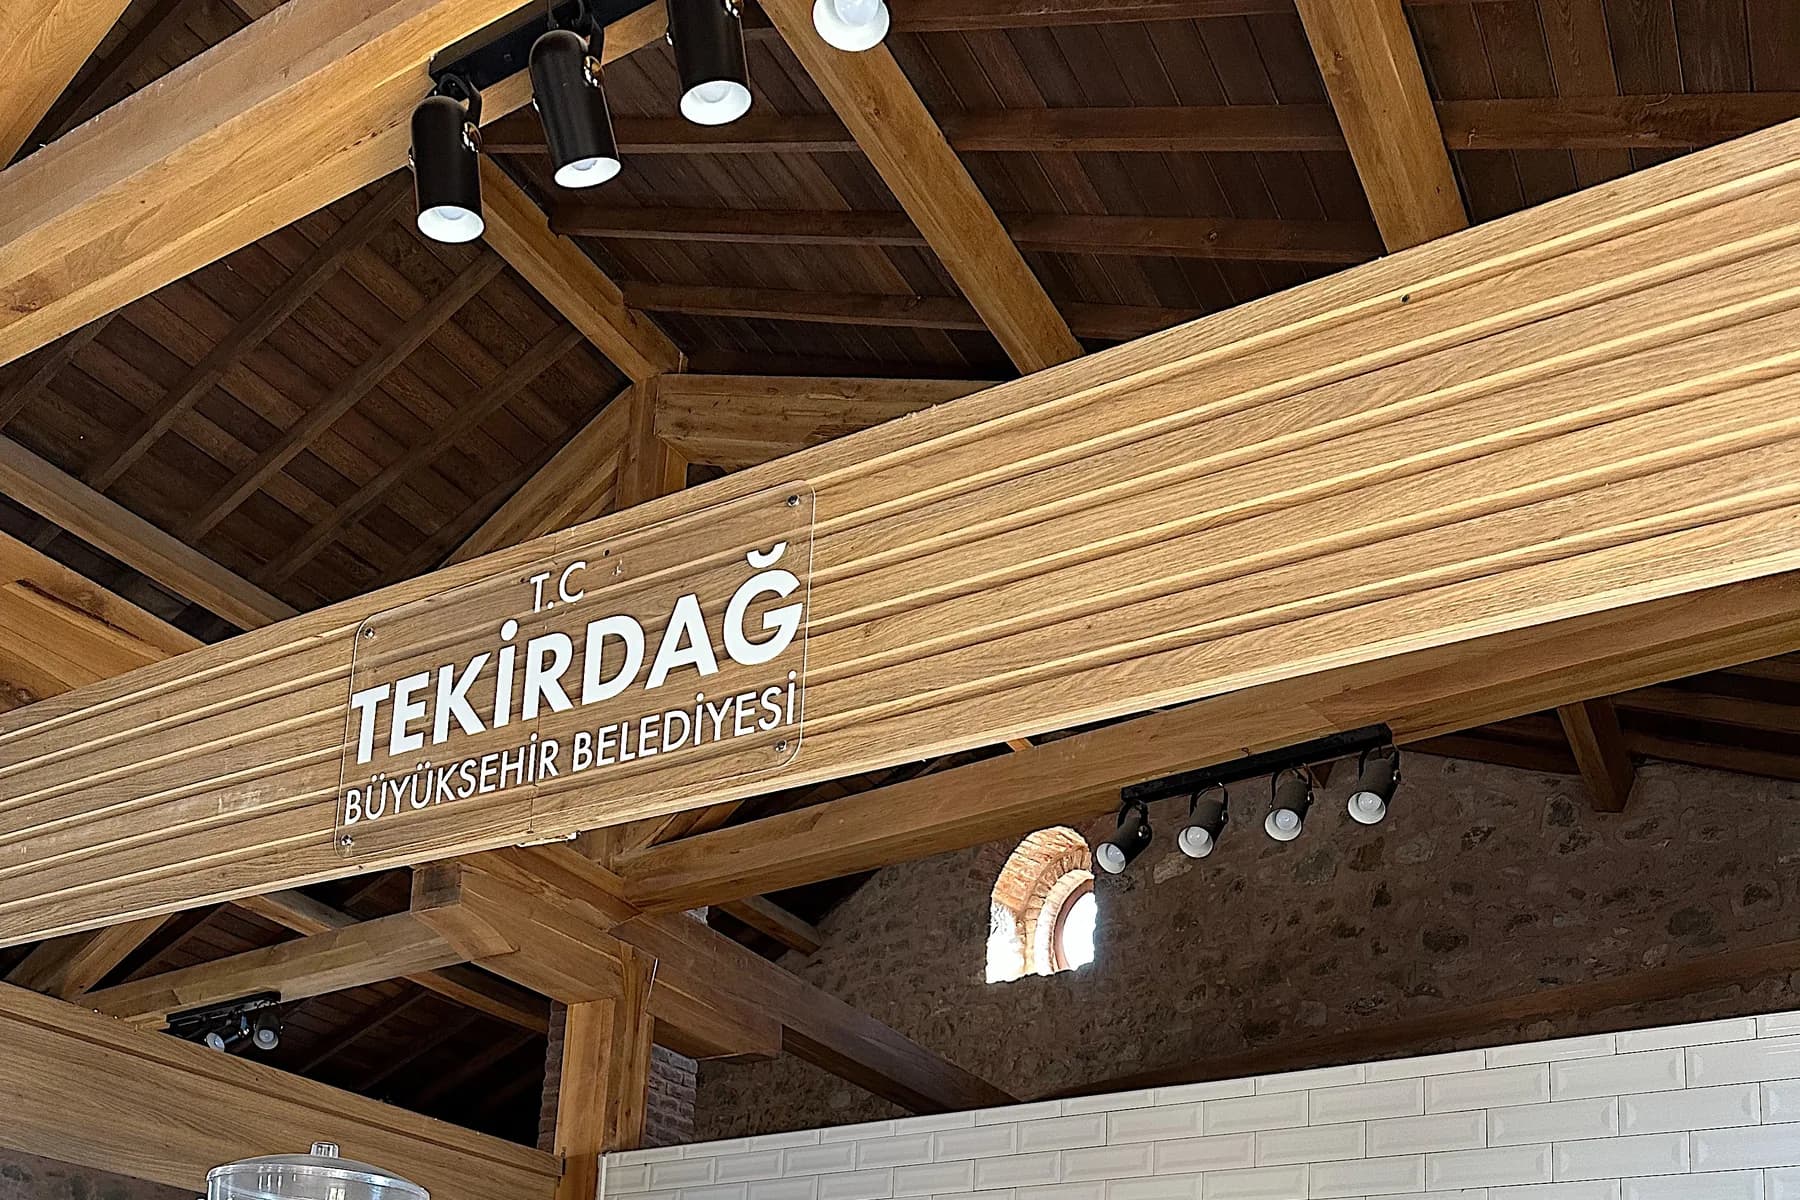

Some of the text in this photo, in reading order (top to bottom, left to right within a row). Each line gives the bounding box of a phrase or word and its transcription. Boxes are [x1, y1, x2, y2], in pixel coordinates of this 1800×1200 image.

[530, 561, 586, 613] T.C
[350, 542, 804, 765] TEKİRDAĞ
[572, 670, 798, 772] BELEDİYESİ
